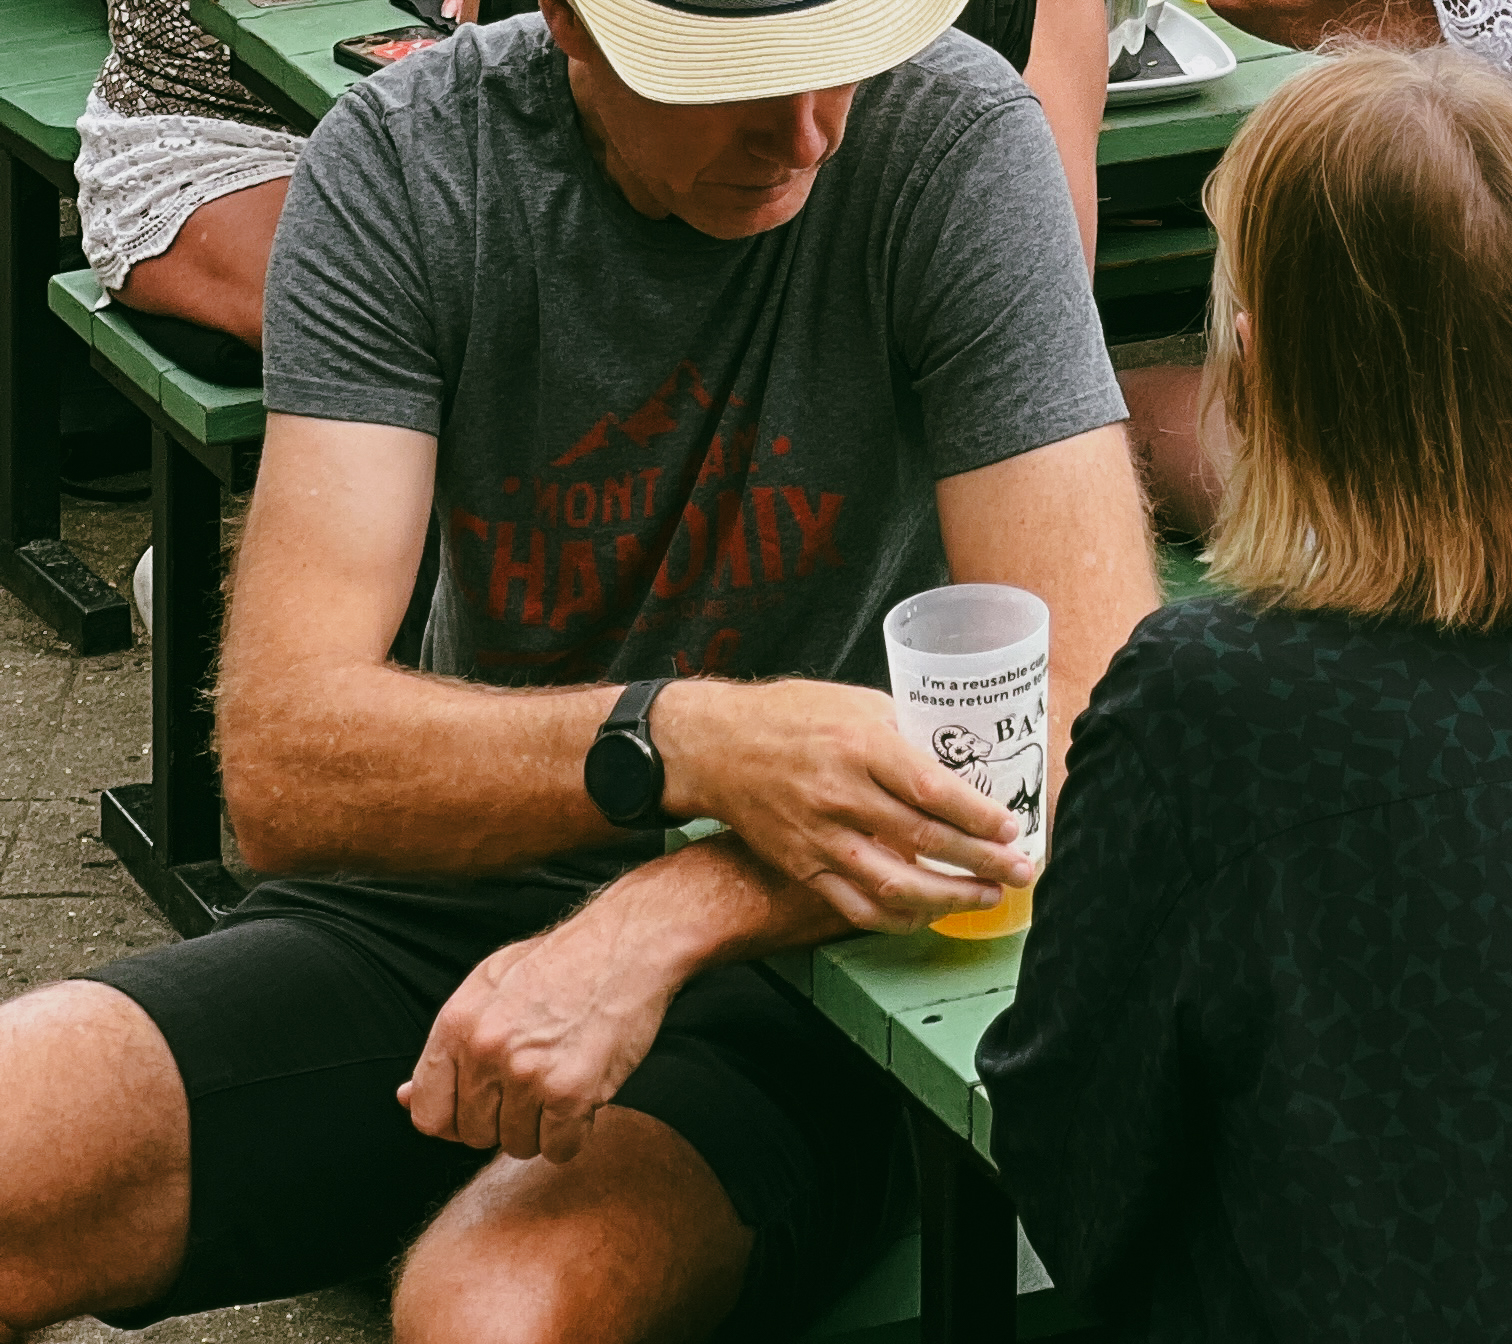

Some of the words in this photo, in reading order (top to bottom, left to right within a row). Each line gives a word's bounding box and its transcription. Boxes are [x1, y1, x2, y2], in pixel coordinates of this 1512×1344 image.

[921, 675, 946, 691] I'm
[949, 680, 958, 691] a
[962, 667, 1028, 691] reusable
[909, 690, 955, 707] please
[959, 691, 1009, 707] return
[1012, 681, 1032, 697] me
